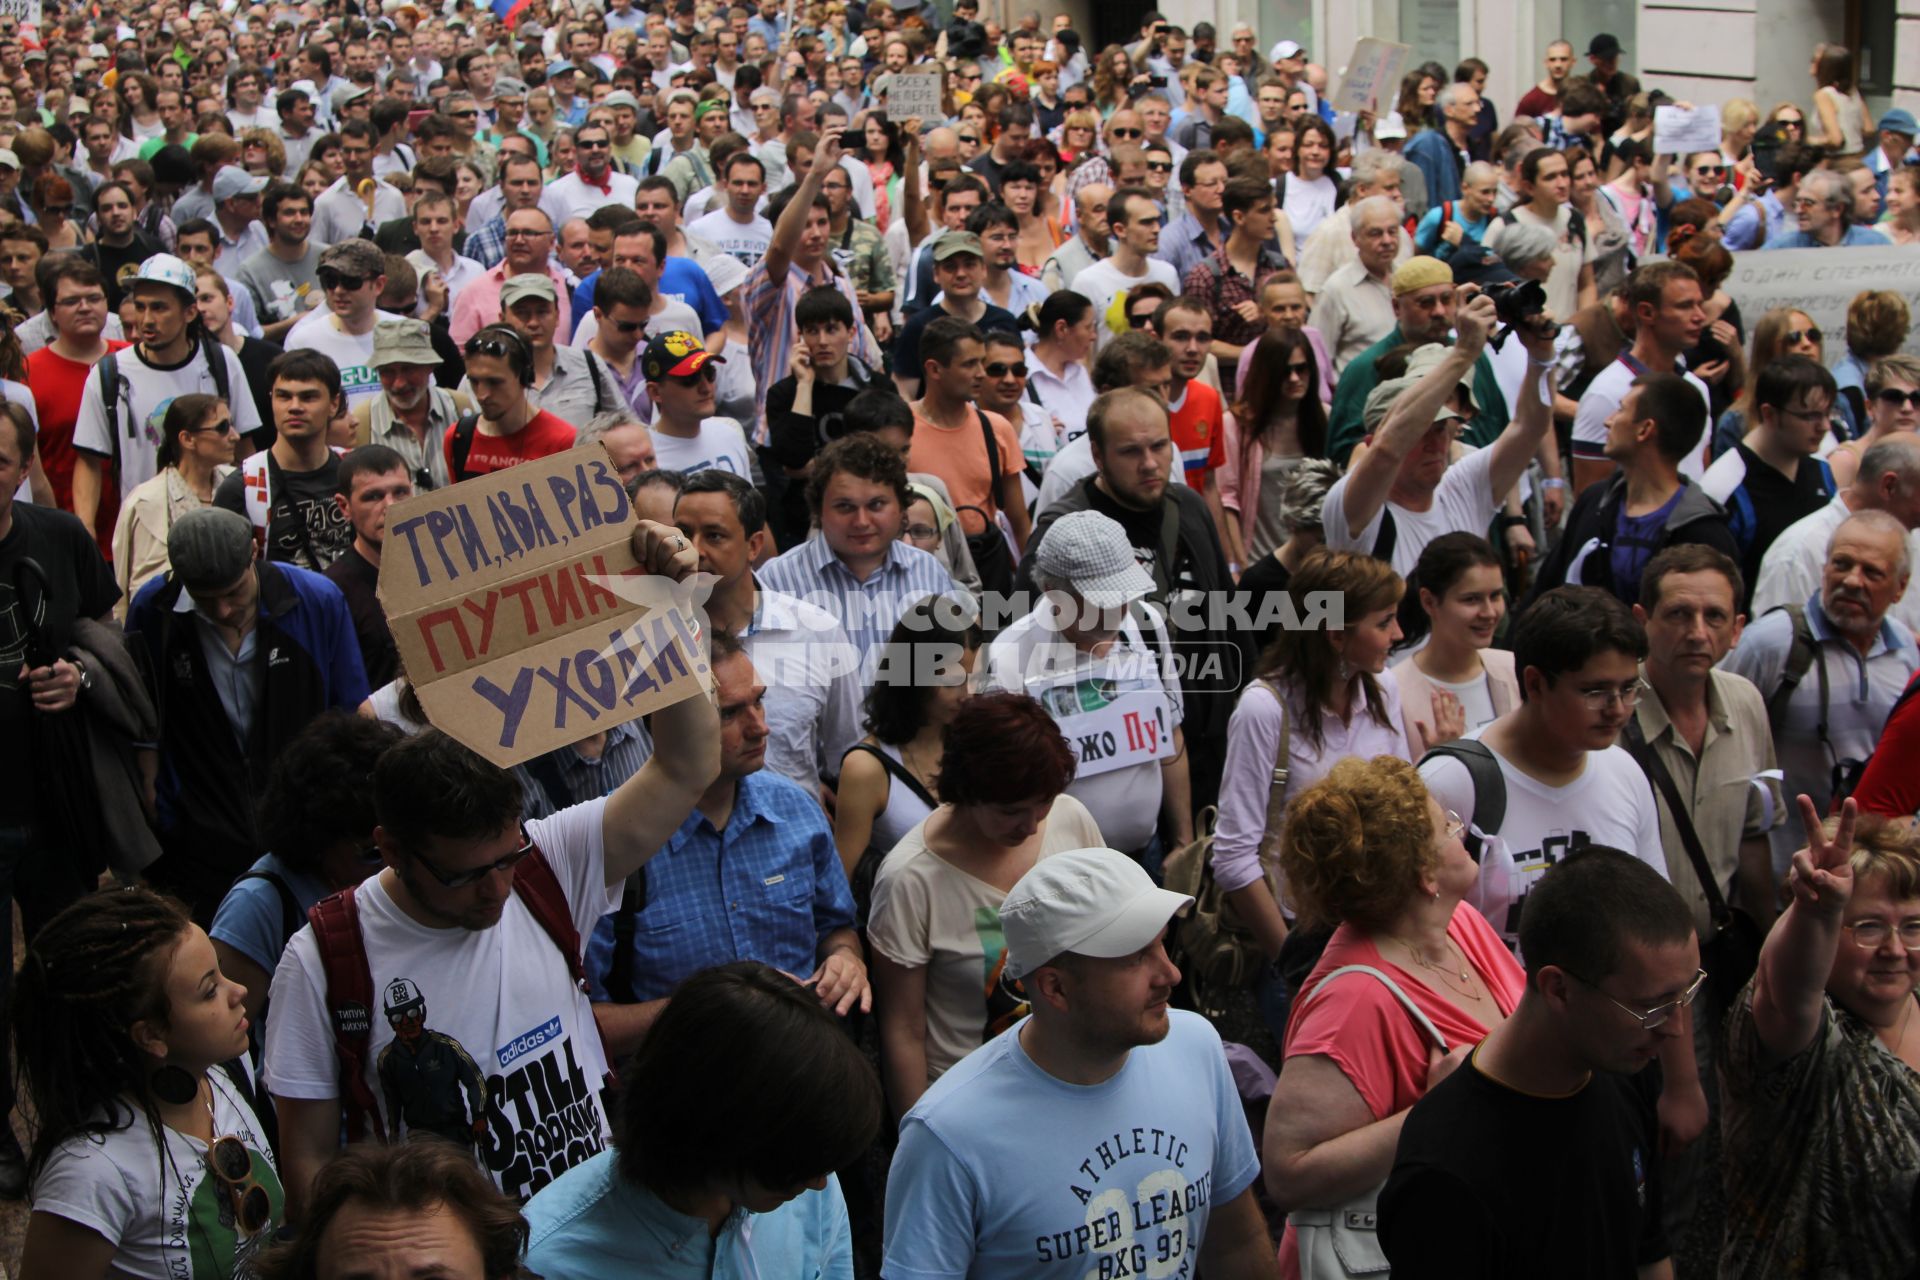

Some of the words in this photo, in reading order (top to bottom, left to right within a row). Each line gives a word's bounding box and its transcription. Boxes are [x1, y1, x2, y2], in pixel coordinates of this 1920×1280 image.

[896, 76, 930, 87] ВСЕХ
[416, 555, 618, 673] ПУТИН
[471, 608, 708, 748] УХОДИ!
[1122, 706, 1168, 754] Пу!
[336, 1008, 366, 1020] ТИПУН
[501, 1031, 546, 1065] adidas
[484, 1034, 590, 1171] STILL
[1070, 1128, 1188, 1205] ATHLETIC
[1036, 1211, 1122, 1263] SUPER
[1132, 1171, 1211, 1231] LEAGUE
[1157, 1229, 1182, 1263] 93
